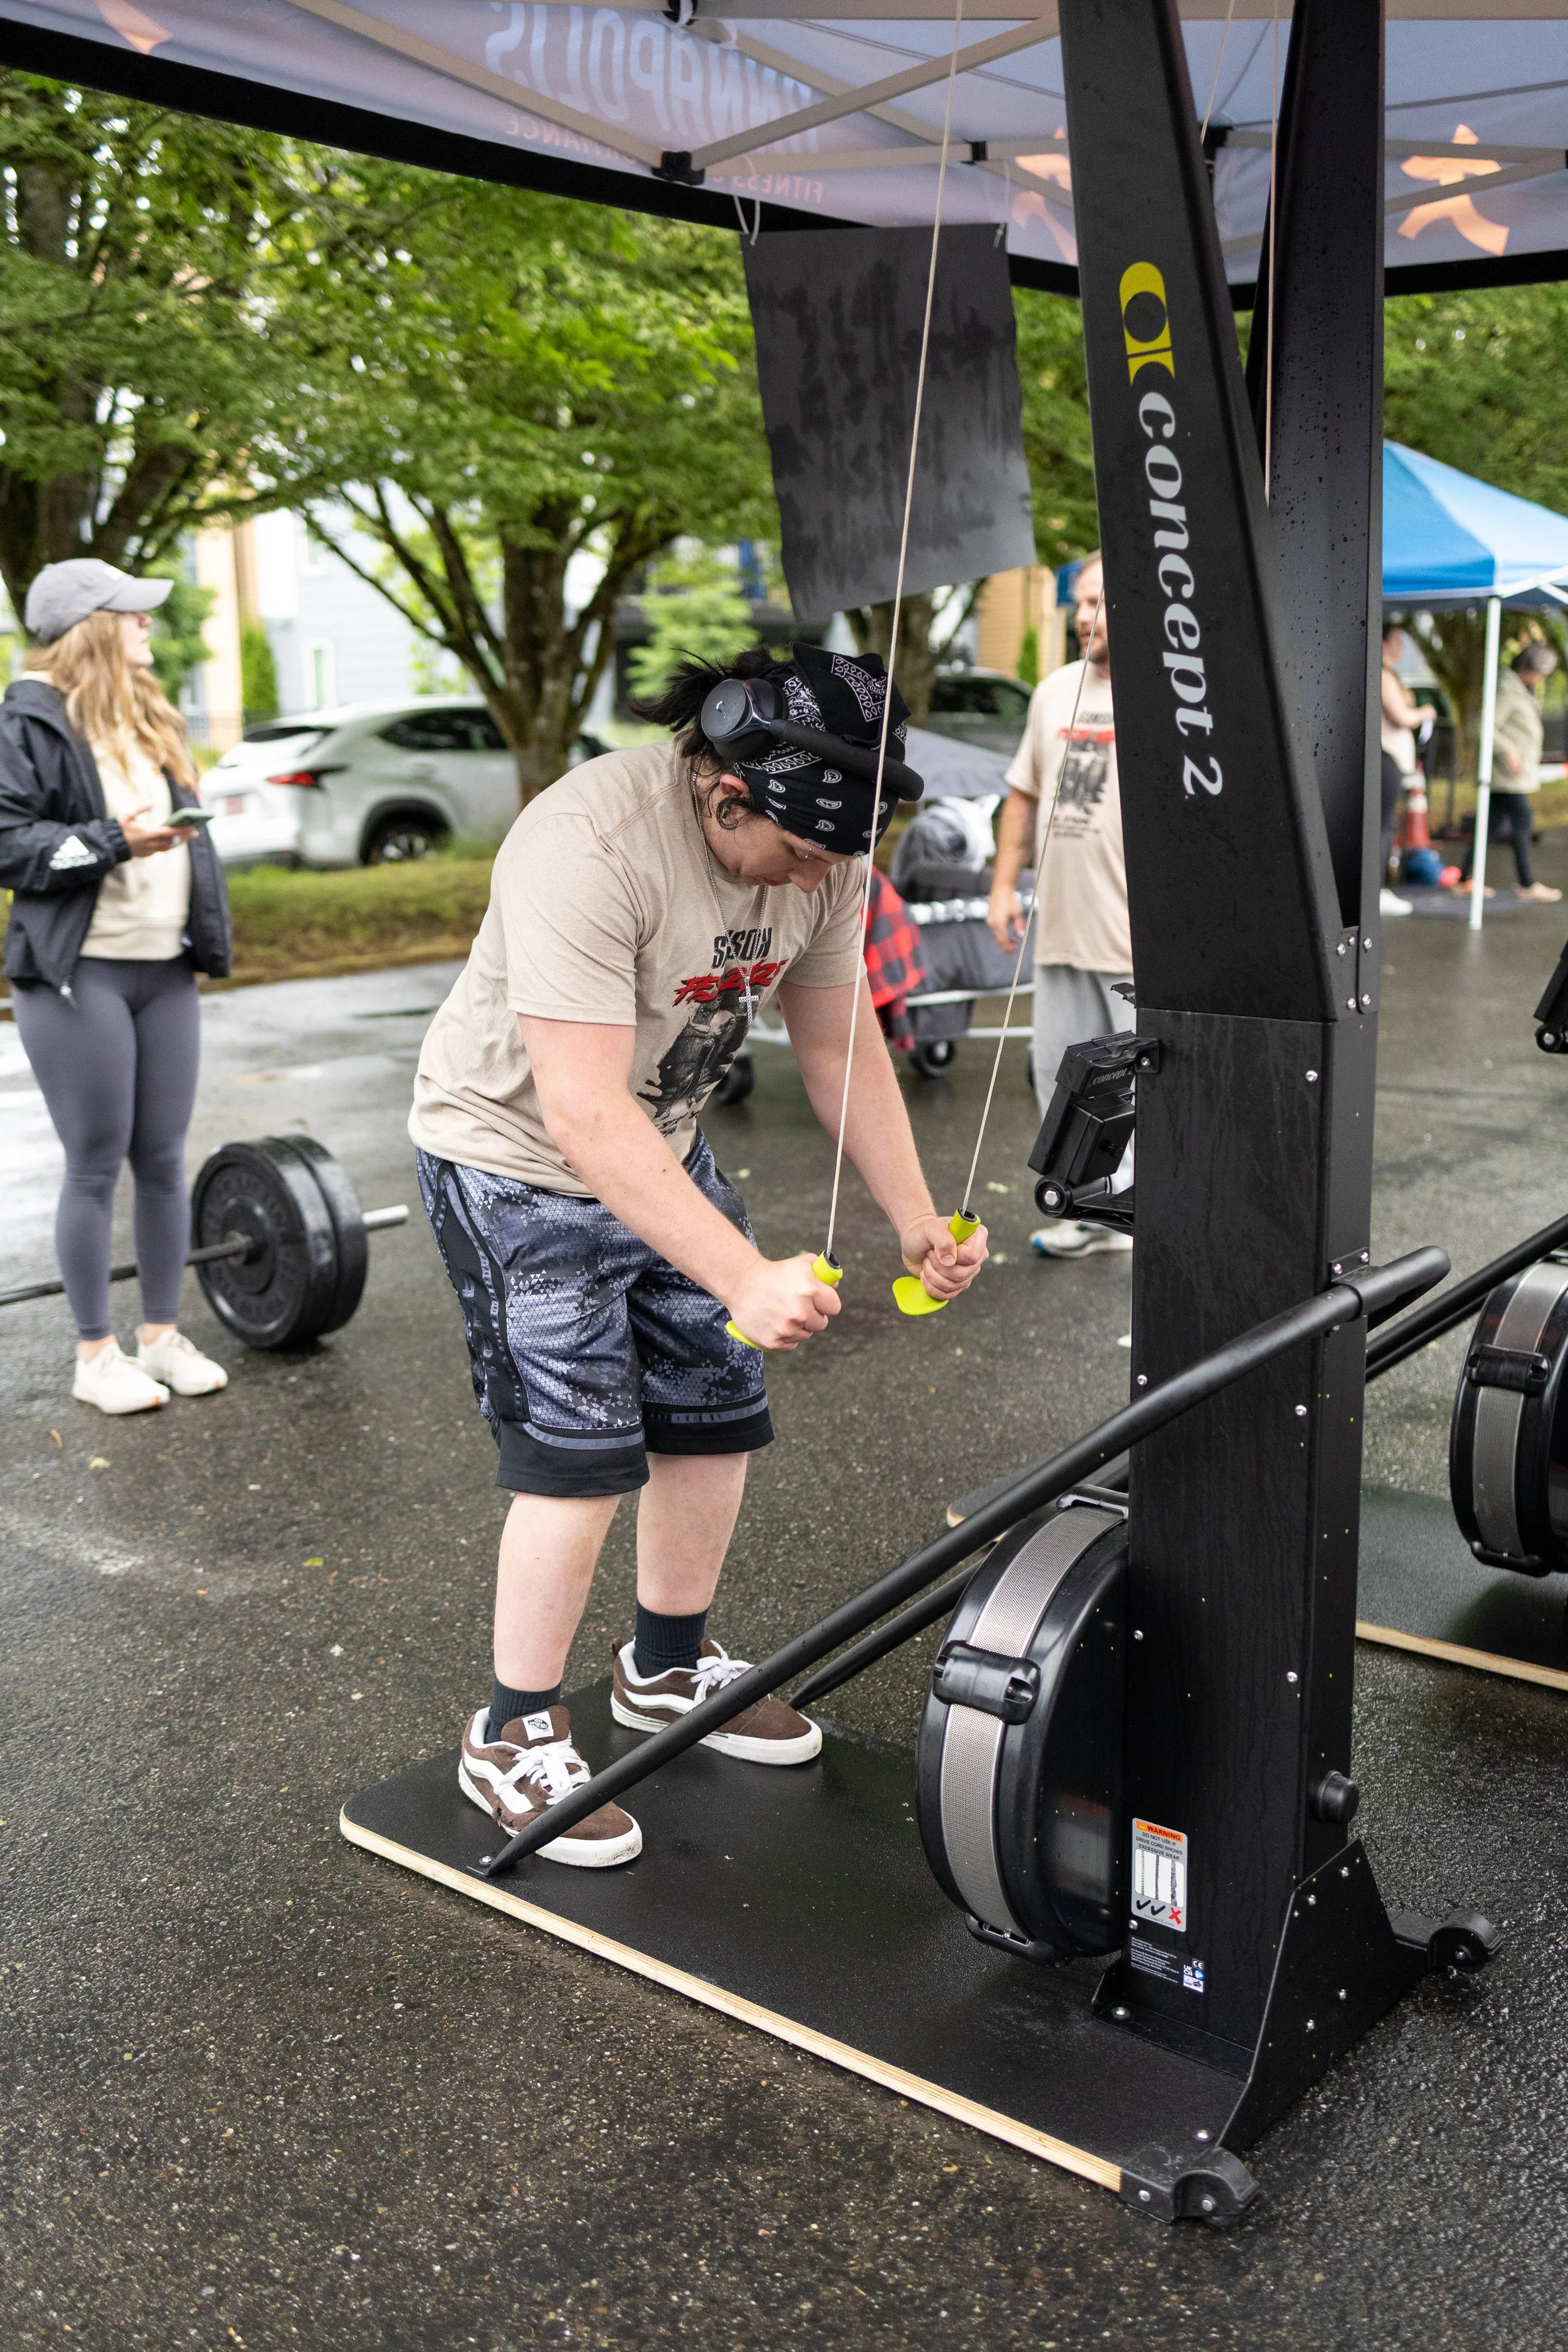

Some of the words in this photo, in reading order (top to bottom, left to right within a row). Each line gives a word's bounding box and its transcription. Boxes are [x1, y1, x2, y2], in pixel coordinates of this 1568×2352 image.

[1140, 393, 1213, 735] concept
[1184, 756, 1222, 795] 2
[1093, 1067, 1128, 1085] concept
[1147, 1825, 1180, 1841] WARNING
[1136, 1836, 1150, 1845] DRIVE
[1150, 1841, 1163, 1849] CORD
[1165, 1846, 1183, 1855] SHOWS
[1138, 1843, 1165, 1855] EXCESSIVE
[1165, 1851, 1179, 1860] WEAR
